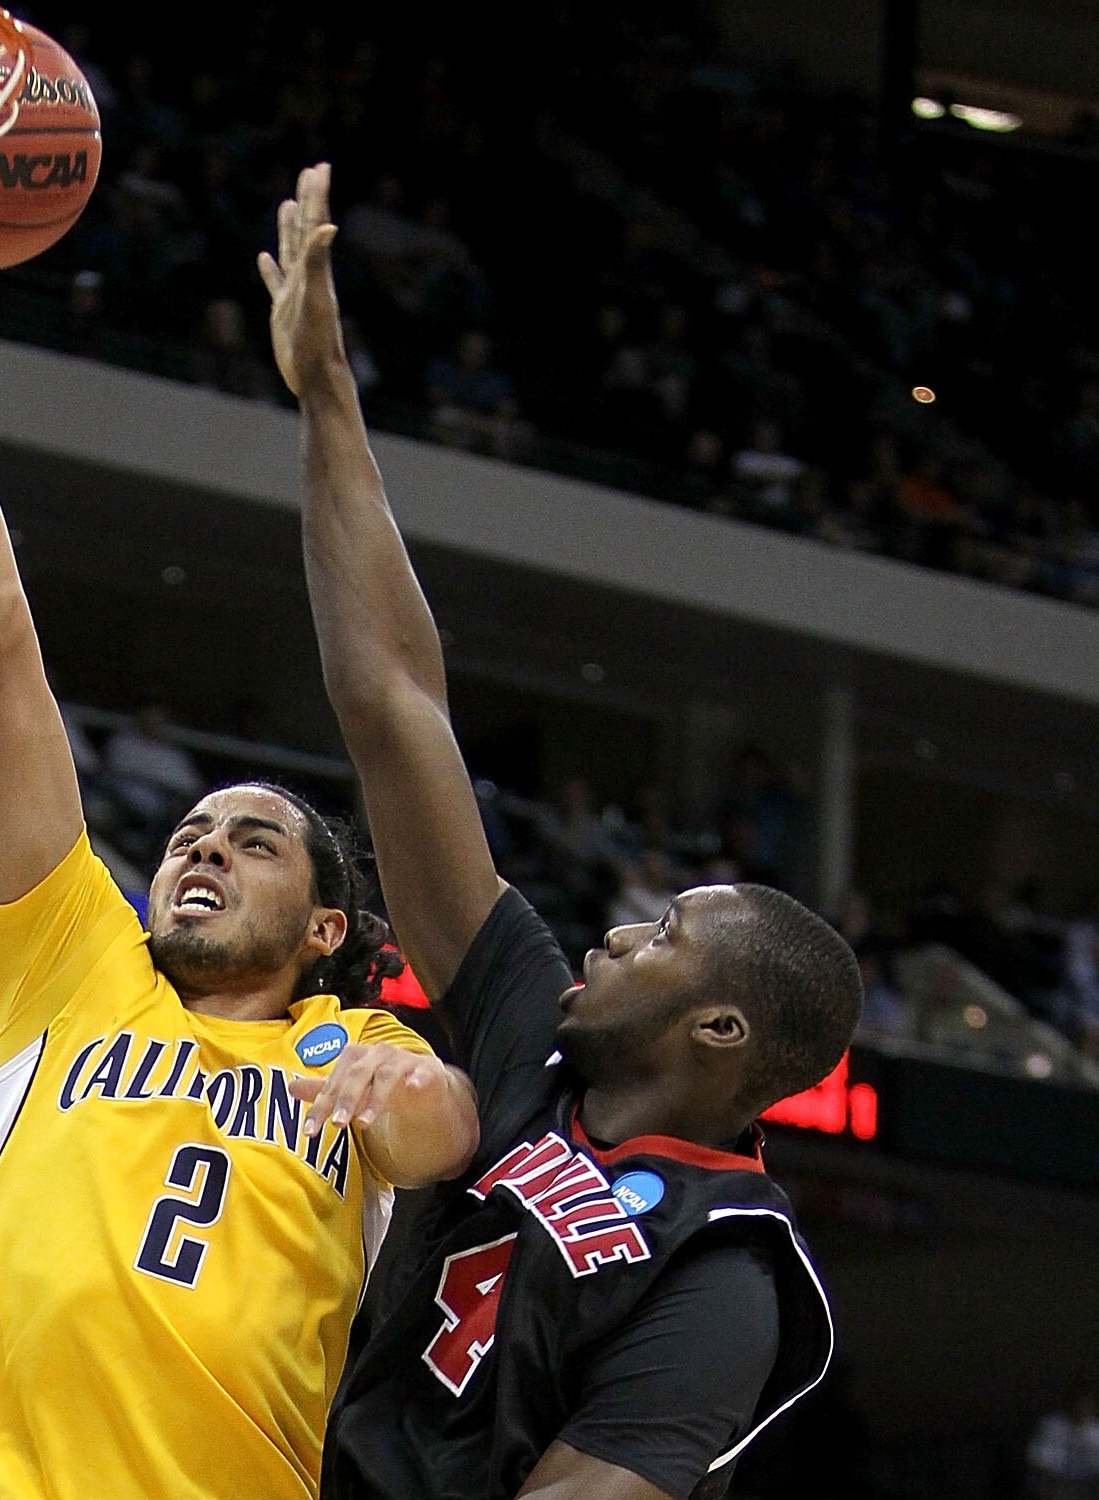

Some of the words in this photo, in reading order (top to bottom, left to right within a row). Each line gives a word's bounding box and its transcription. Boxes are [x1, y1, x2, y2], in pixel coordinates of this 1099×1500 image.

[303, 1038, 341, 1060] NCAA
[132, 1142, 233, 1291] 2
[612, 1185, 648, 1213] NCAA
[420, 1231, 519, 1398] 4
